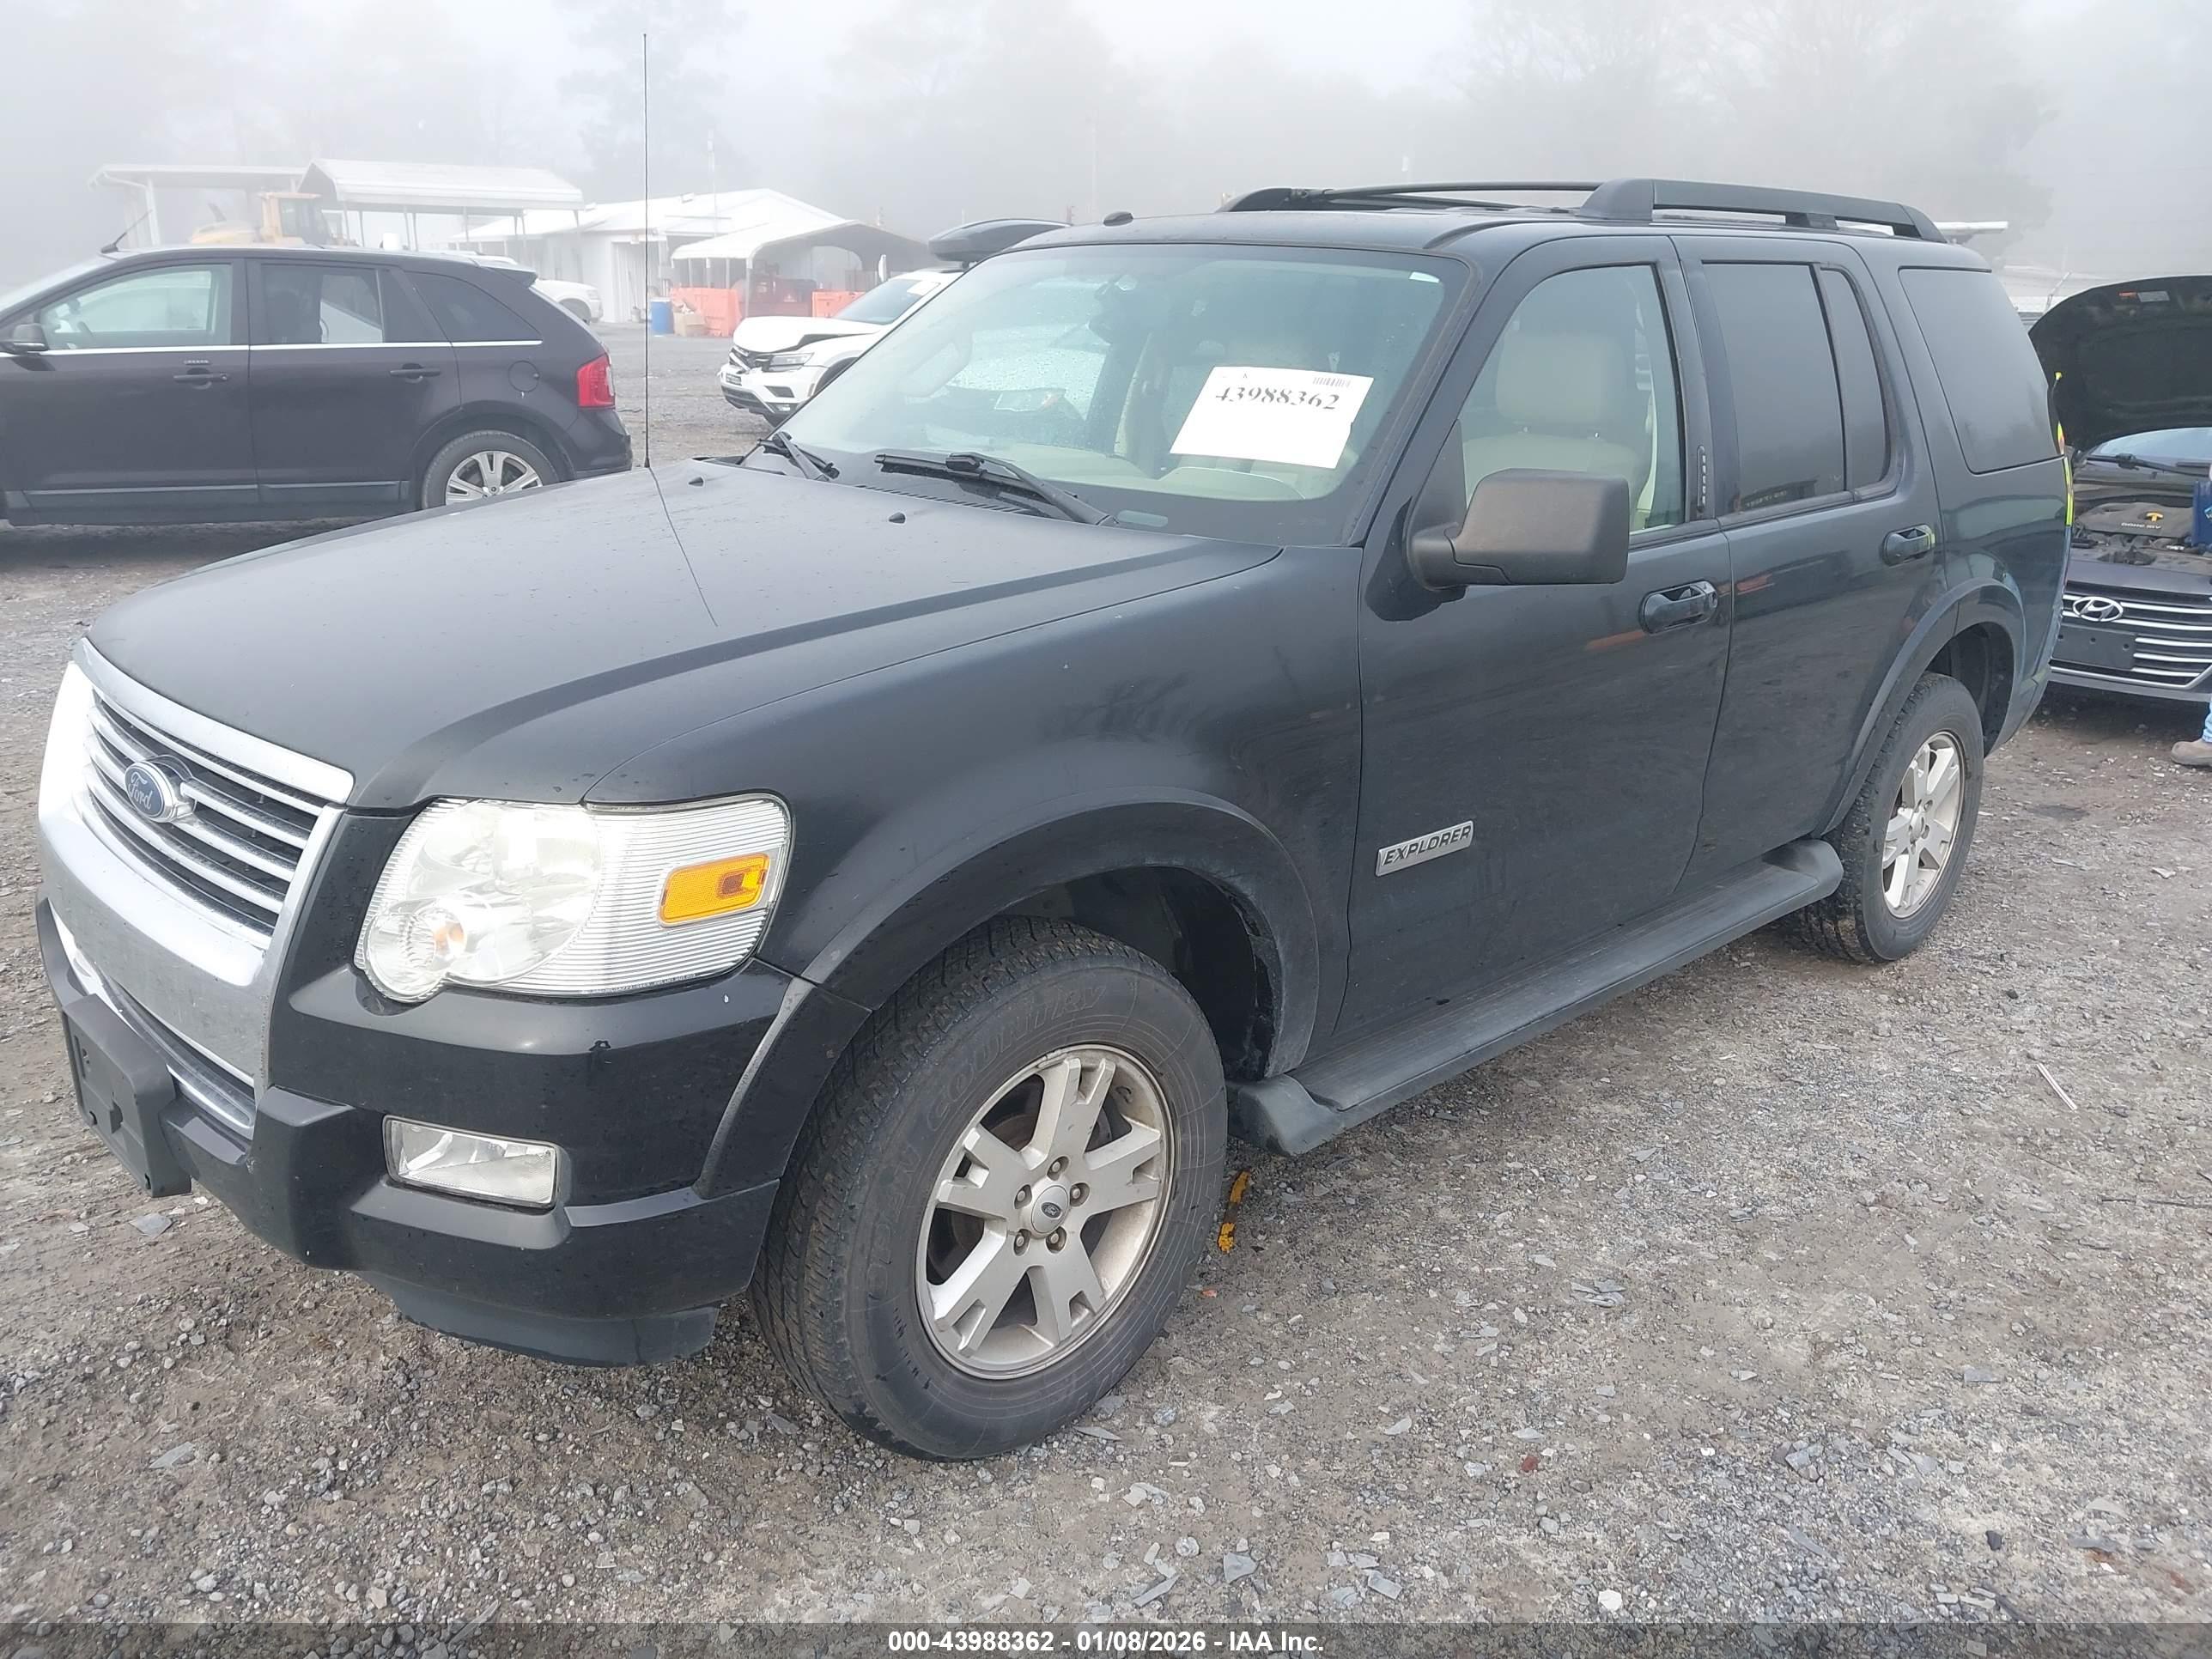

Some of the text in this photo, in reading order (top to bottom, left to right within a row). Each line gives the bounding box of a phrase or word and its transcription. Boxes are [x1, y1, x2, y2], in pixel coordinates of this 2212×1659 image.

[1215, 386, 1340, 410] 43988362
[128, 771, 153, 811] Ford
[1382, 824, 1472, 866] EXPLORER
[927, 985, 1107, 1132] COUNTRY
